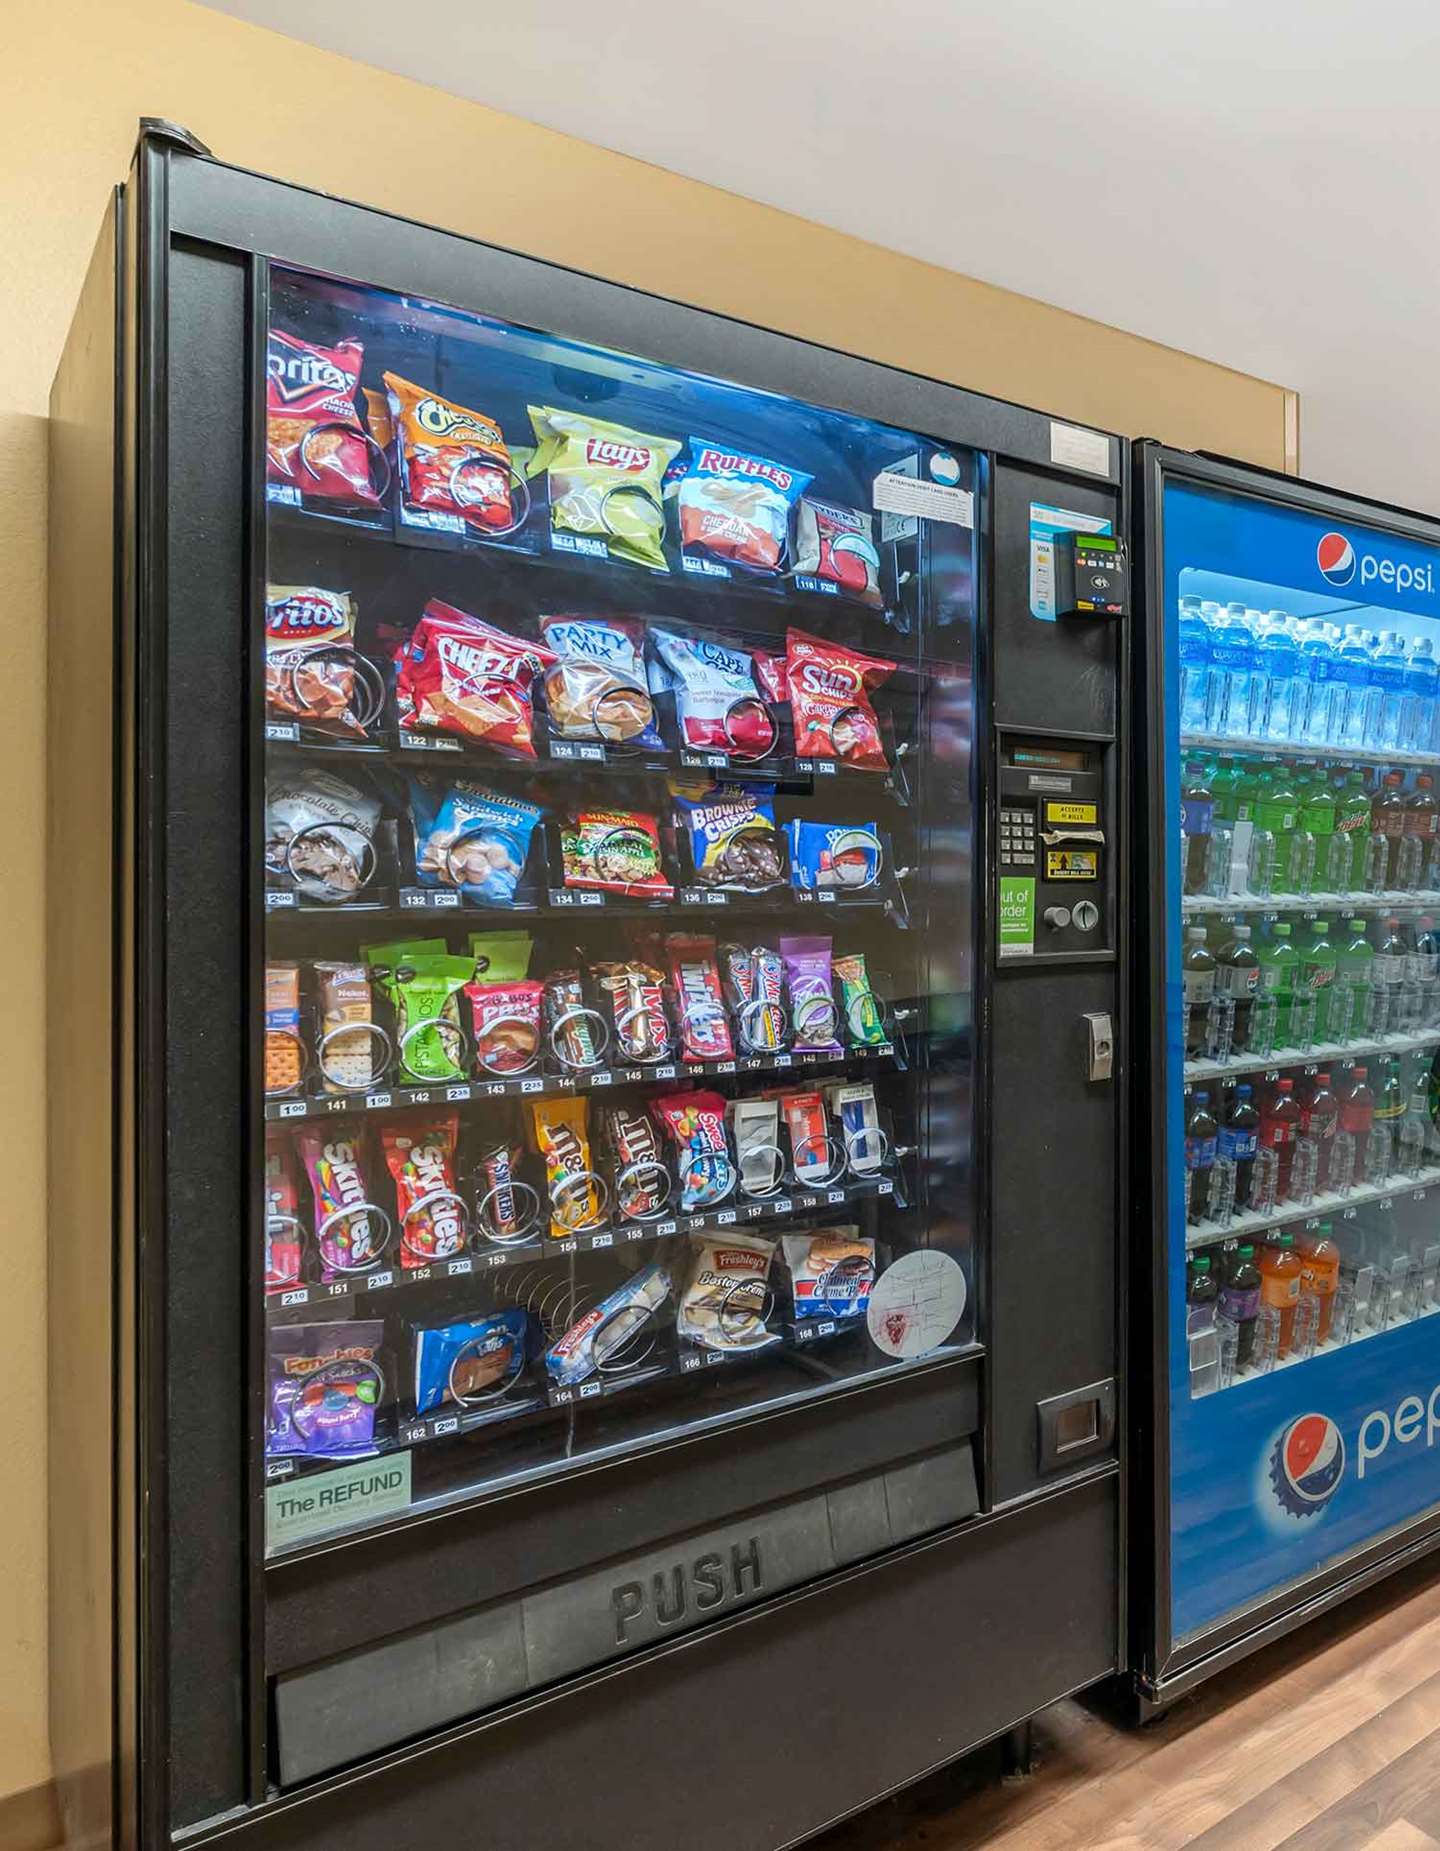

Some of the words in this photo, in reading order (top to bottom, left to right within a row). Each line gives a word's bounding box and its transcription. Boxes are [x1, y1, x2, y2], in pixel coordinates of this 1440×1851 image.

[266, 354, 357, 393] oritos
[701, 450, 792, 490] RUFFLES
[1360, 554, 1434, 594] pepsi
[551, 626, 628, 650] PARTY
[571, 638, 616, 662] MIX
[407, 736, 427, 746] 122
[554, 747, 572, 757] 124
[691, 797, 757, 832] BROWNIE
[704, 811, 755, 842] CRISPS
[405, 896, 426, 905] 132
[555, 895, 573, 904] 134
[1016, 889, 1029, 903] of
[640, 985, 667, 1047] TWIX
[687, 1065, 704, 1074] 146
[746, 1059, 761, 1069] 147
[625, 1071, 642, 1081] 145
[486, 1084, 505, 1094] 143
[558, 1078, 575, 1088] 144
[327, 1100, 347, 1110] 141
[370, 1095, 390, 1106] 100
[409, 1092, 430, 1102] 142
[284, 1104, 305, 1115] 100
[748, 1207, 762, 1217] 157
[690, 1218, 705, 1228] 156
[626, 1230, 643, 1240] 155
[559, 1241, 577, 1252] 154
[487, 1255, 506, 1266] 153
[411, 1268, 431, 1280] 152
[450, 1262, 470, 1273] 210
[327, 1284, 348, 1296] 151
[369, 1274, 389, 1288] 210
[284, 1291, 305, 1304] 210
[684, 1358, 700, 1369] 166
[554, 1391, 573, 1402] 164
[582, 1384, 599, 1395] 200
[406, 1428, 426, 1440] 162
[437, 1420, 456, 1432] 200
[269, 1461, 291, 1475] 200
[276, 1497, 315, 1519] The
[318, 1470, 404, 1508] REFUND
[611, 1535, 764, 1646] PUSH
